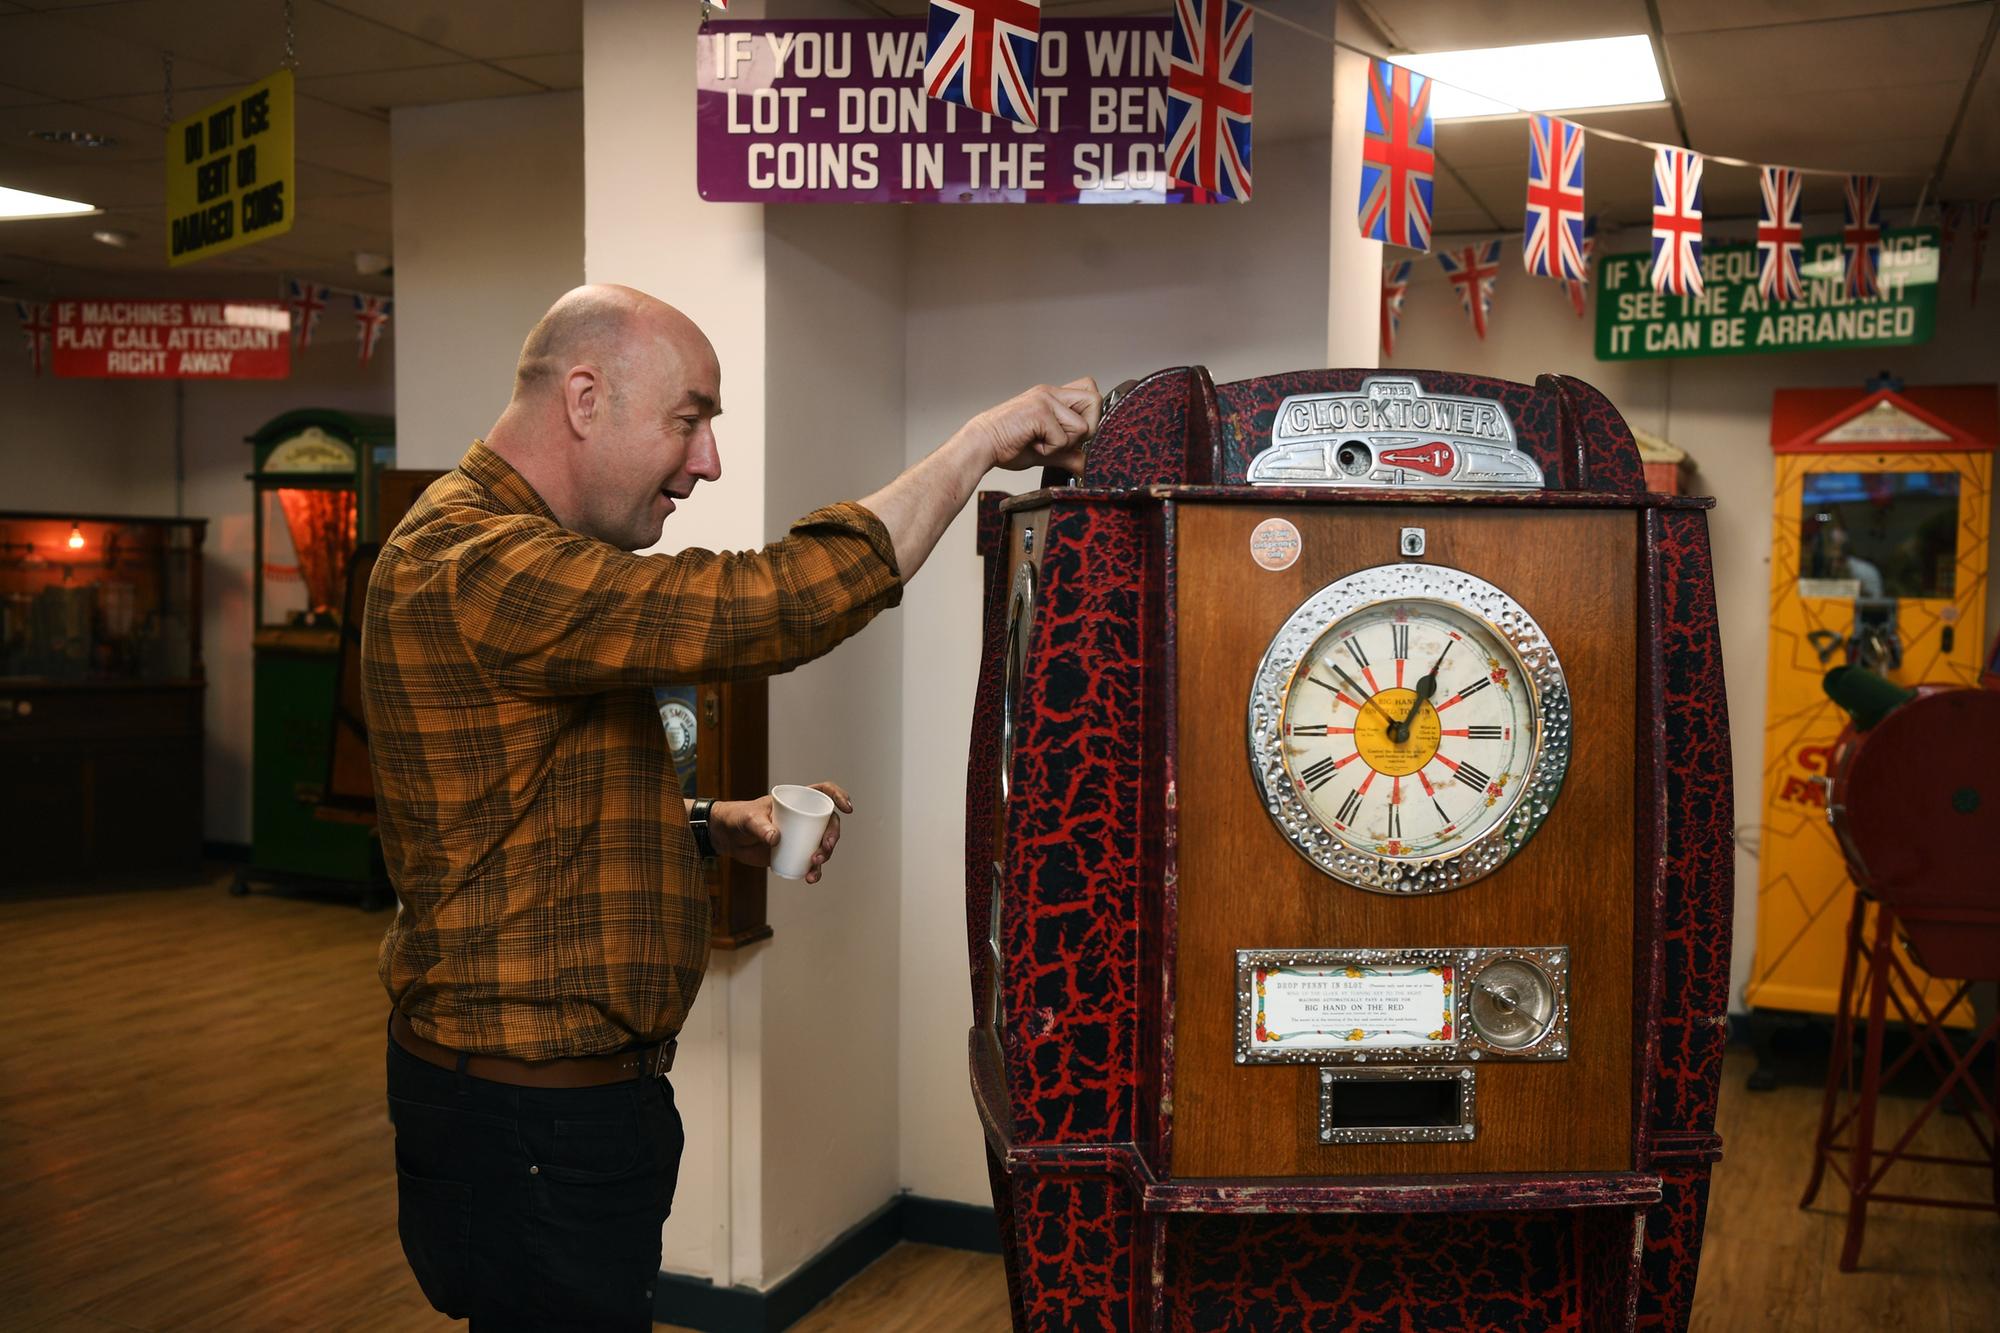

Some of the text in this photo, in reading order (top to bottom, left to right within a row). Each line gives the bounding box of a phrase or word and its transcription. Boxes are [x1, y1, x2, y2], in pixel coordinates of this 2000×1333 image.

[715, 30, 1173, 79] IF YOU WA O WIN
[184, 87, 270, 165] DO NOT USE
[838, 87, 957, 134] DON
[1090, 87, 1168, 133] BEN
[197, 143, 257, 204] BENT OR
[748, 142, 880, 190] COINS
[902, 143, 944, 190] IN
[962, 142, 1046, 190] THE
[173, 179, 284, 256] DAMAGED COINS
[1605, 262, 1629, 290] IF
[1815, 234, 1932, 273] CNGE
[58, 302, 77, 325] IF
[82, 302, 183, 325] MACHINES
[189, 302, 231, 325] WIL
[1617, 270, 1910, 322] SEE THE AENDNT
[57, 327, 281, 351] PLAY CALL ATTENDANT
[1610, 305, 1915, 354] IT CAN BE ARRANGED
[106, 350, 234, 374] RIGHT AWAY
[1289, 399, 1499, 438] CLOCKTOWER
[1387, 1003, 1405, 1011] RED
